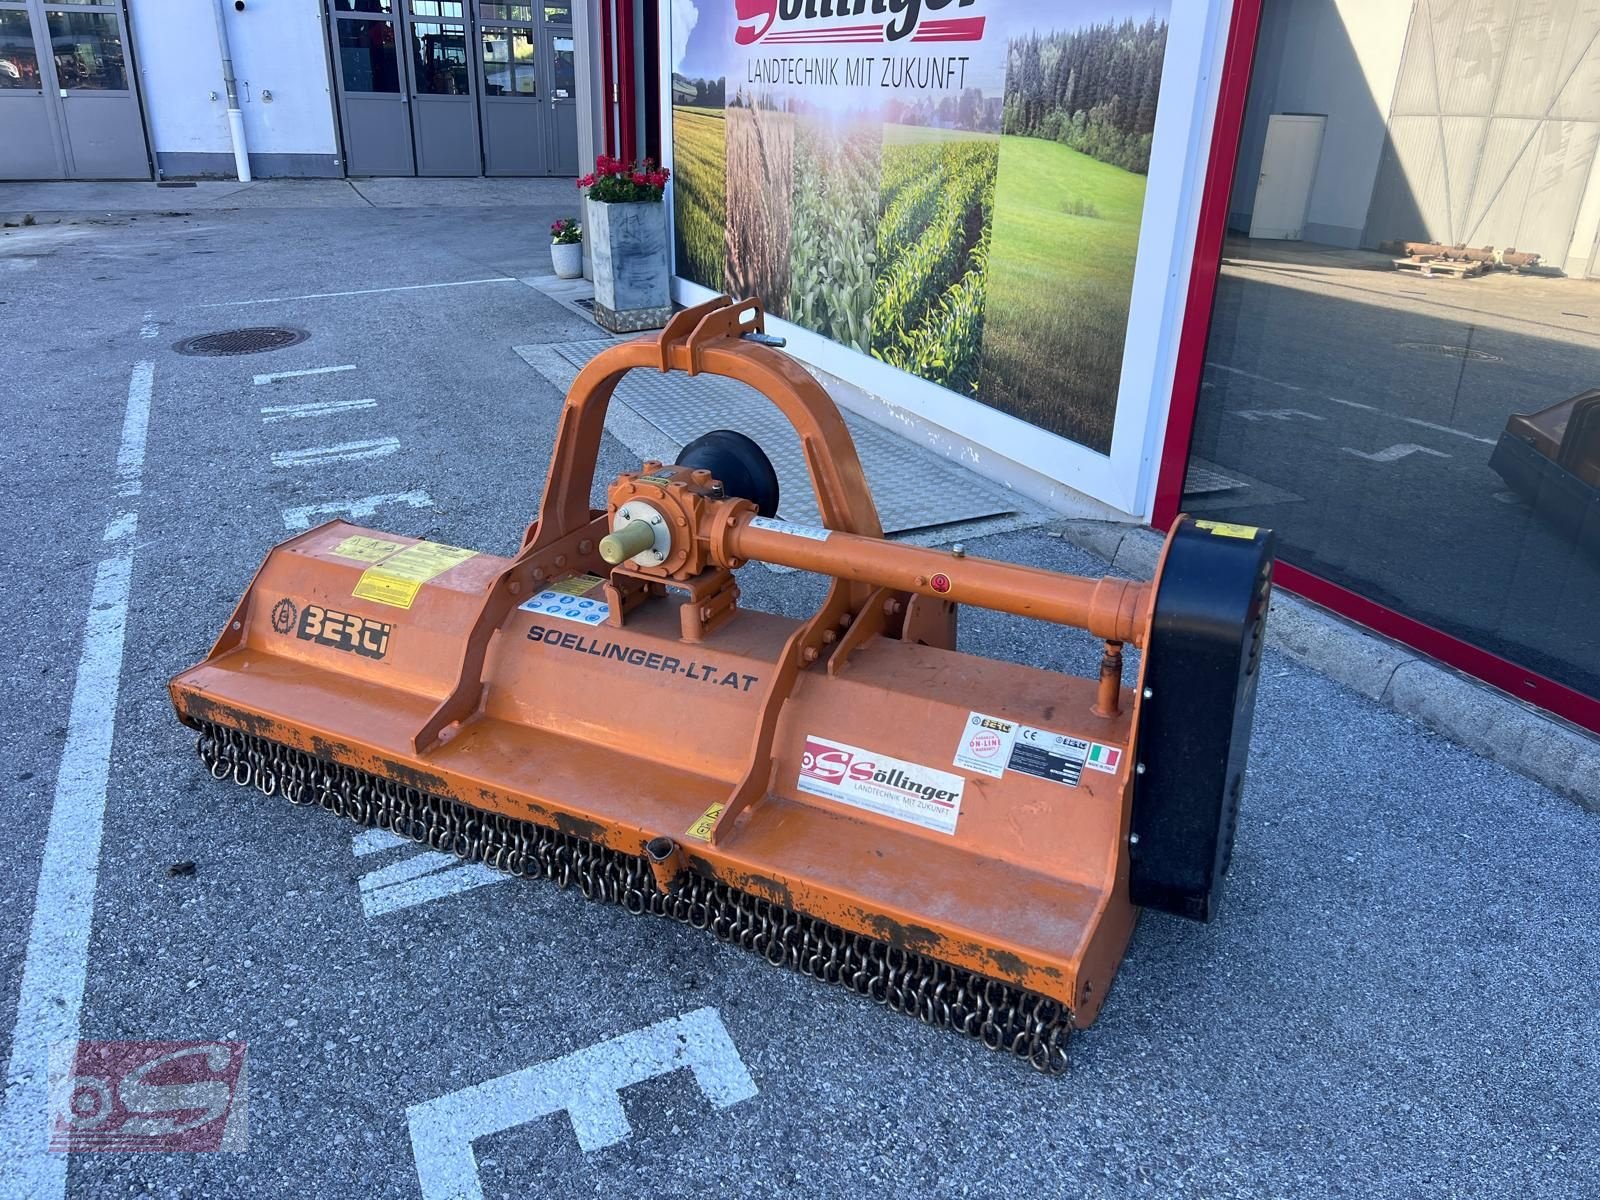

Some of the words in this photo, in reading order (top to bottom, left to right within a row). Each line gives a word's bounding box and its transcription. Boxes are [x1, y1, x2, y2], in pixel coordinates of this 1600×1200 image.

[747, 58, 839, 85] LANDTECHNIK
[845, 57, 875, 87] MIT
[880, 57, 970, 89] ZUKUNFT
[527, 625, 759, 692] SOELLINGER-LT.AT
[848, 761, 960, 803] Söllinger
[854, 783, 900, 802] LANDTECHNIK
[902, 796, 917, 808] MIT
[917, 801, 950, 816] ZUKUNFT
